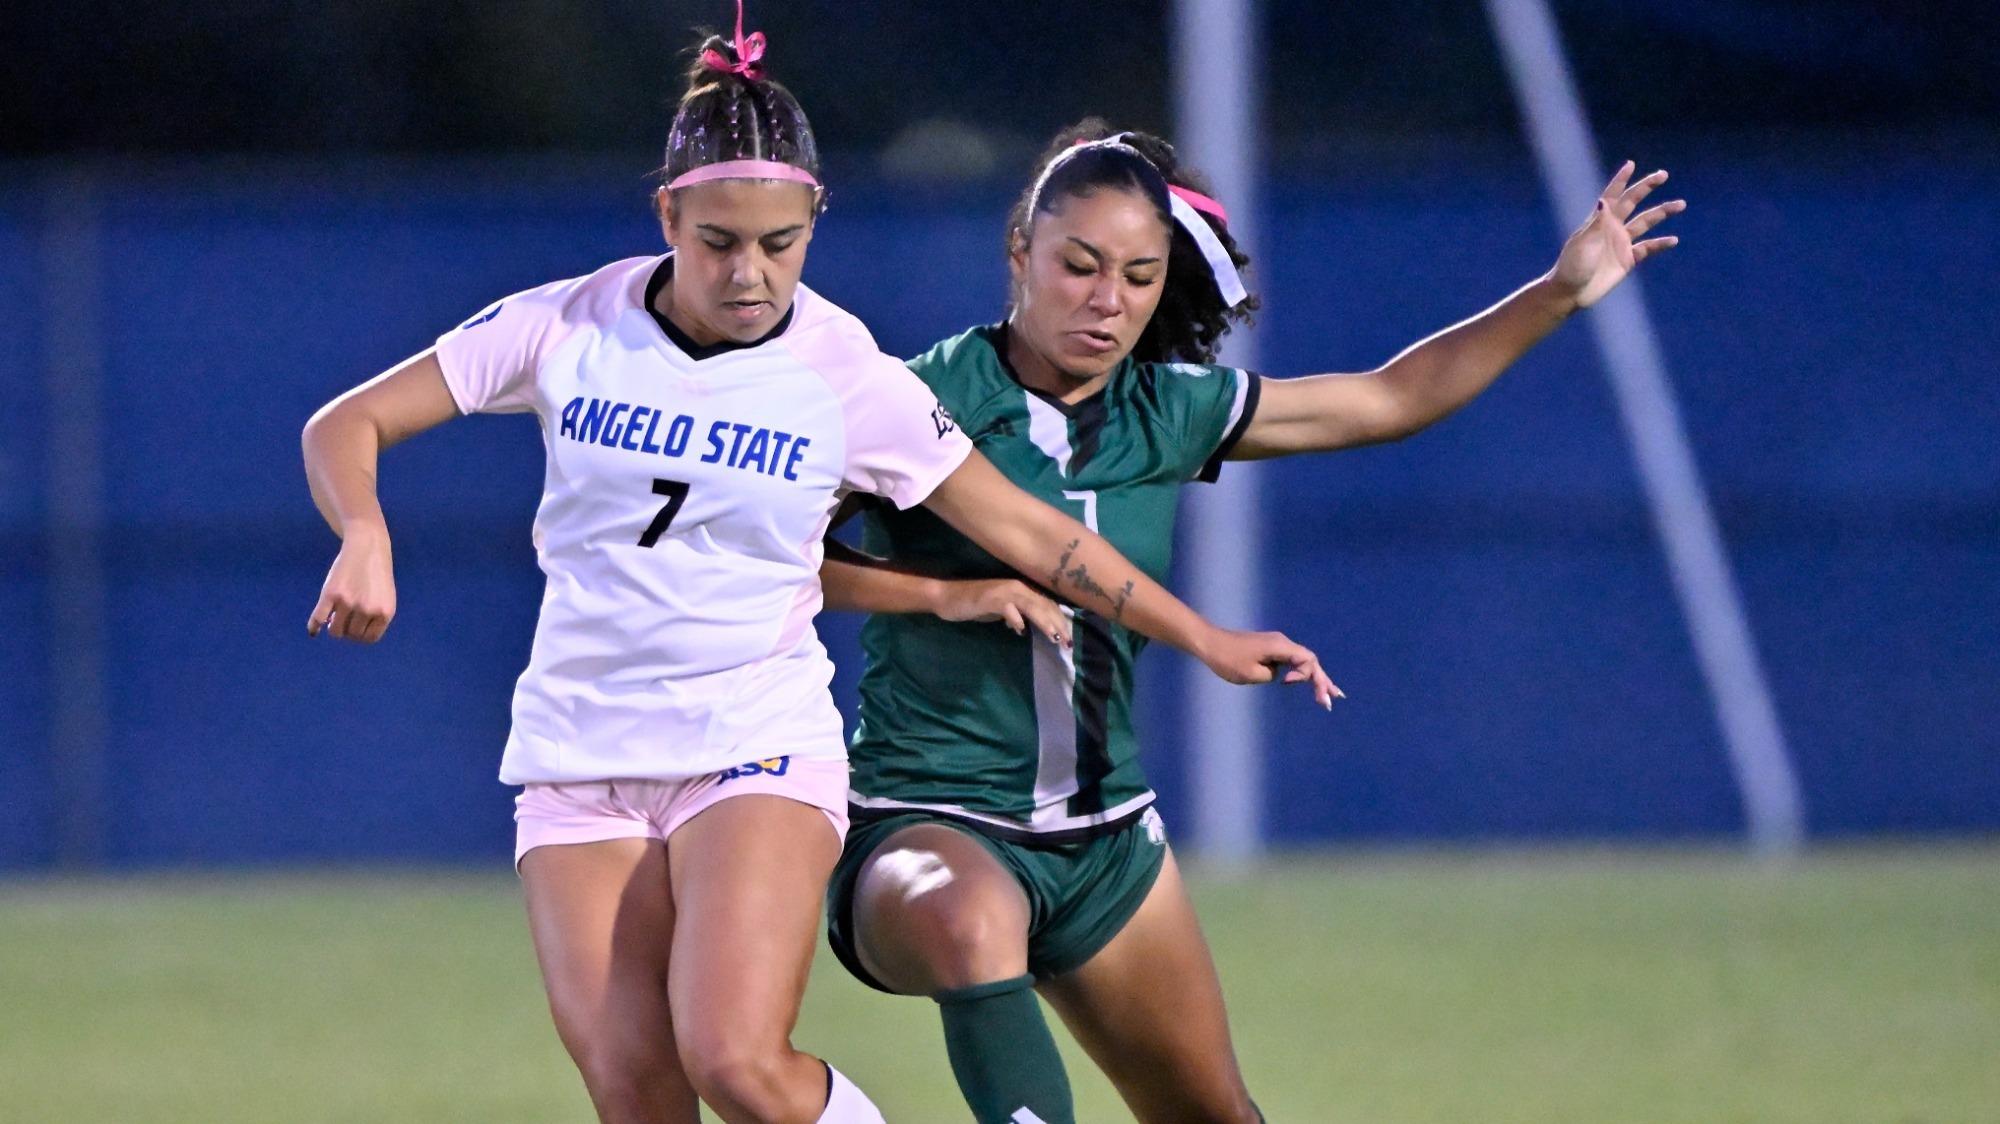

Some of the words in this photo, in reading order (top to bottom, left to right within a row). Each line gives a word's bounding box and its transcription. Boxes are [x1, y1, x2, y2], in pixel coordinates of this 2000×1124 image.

[560, 396, 695, 458] ANGELO
[700, 420, 811, 482] STATE
[637, 477, 690, 549] 7
